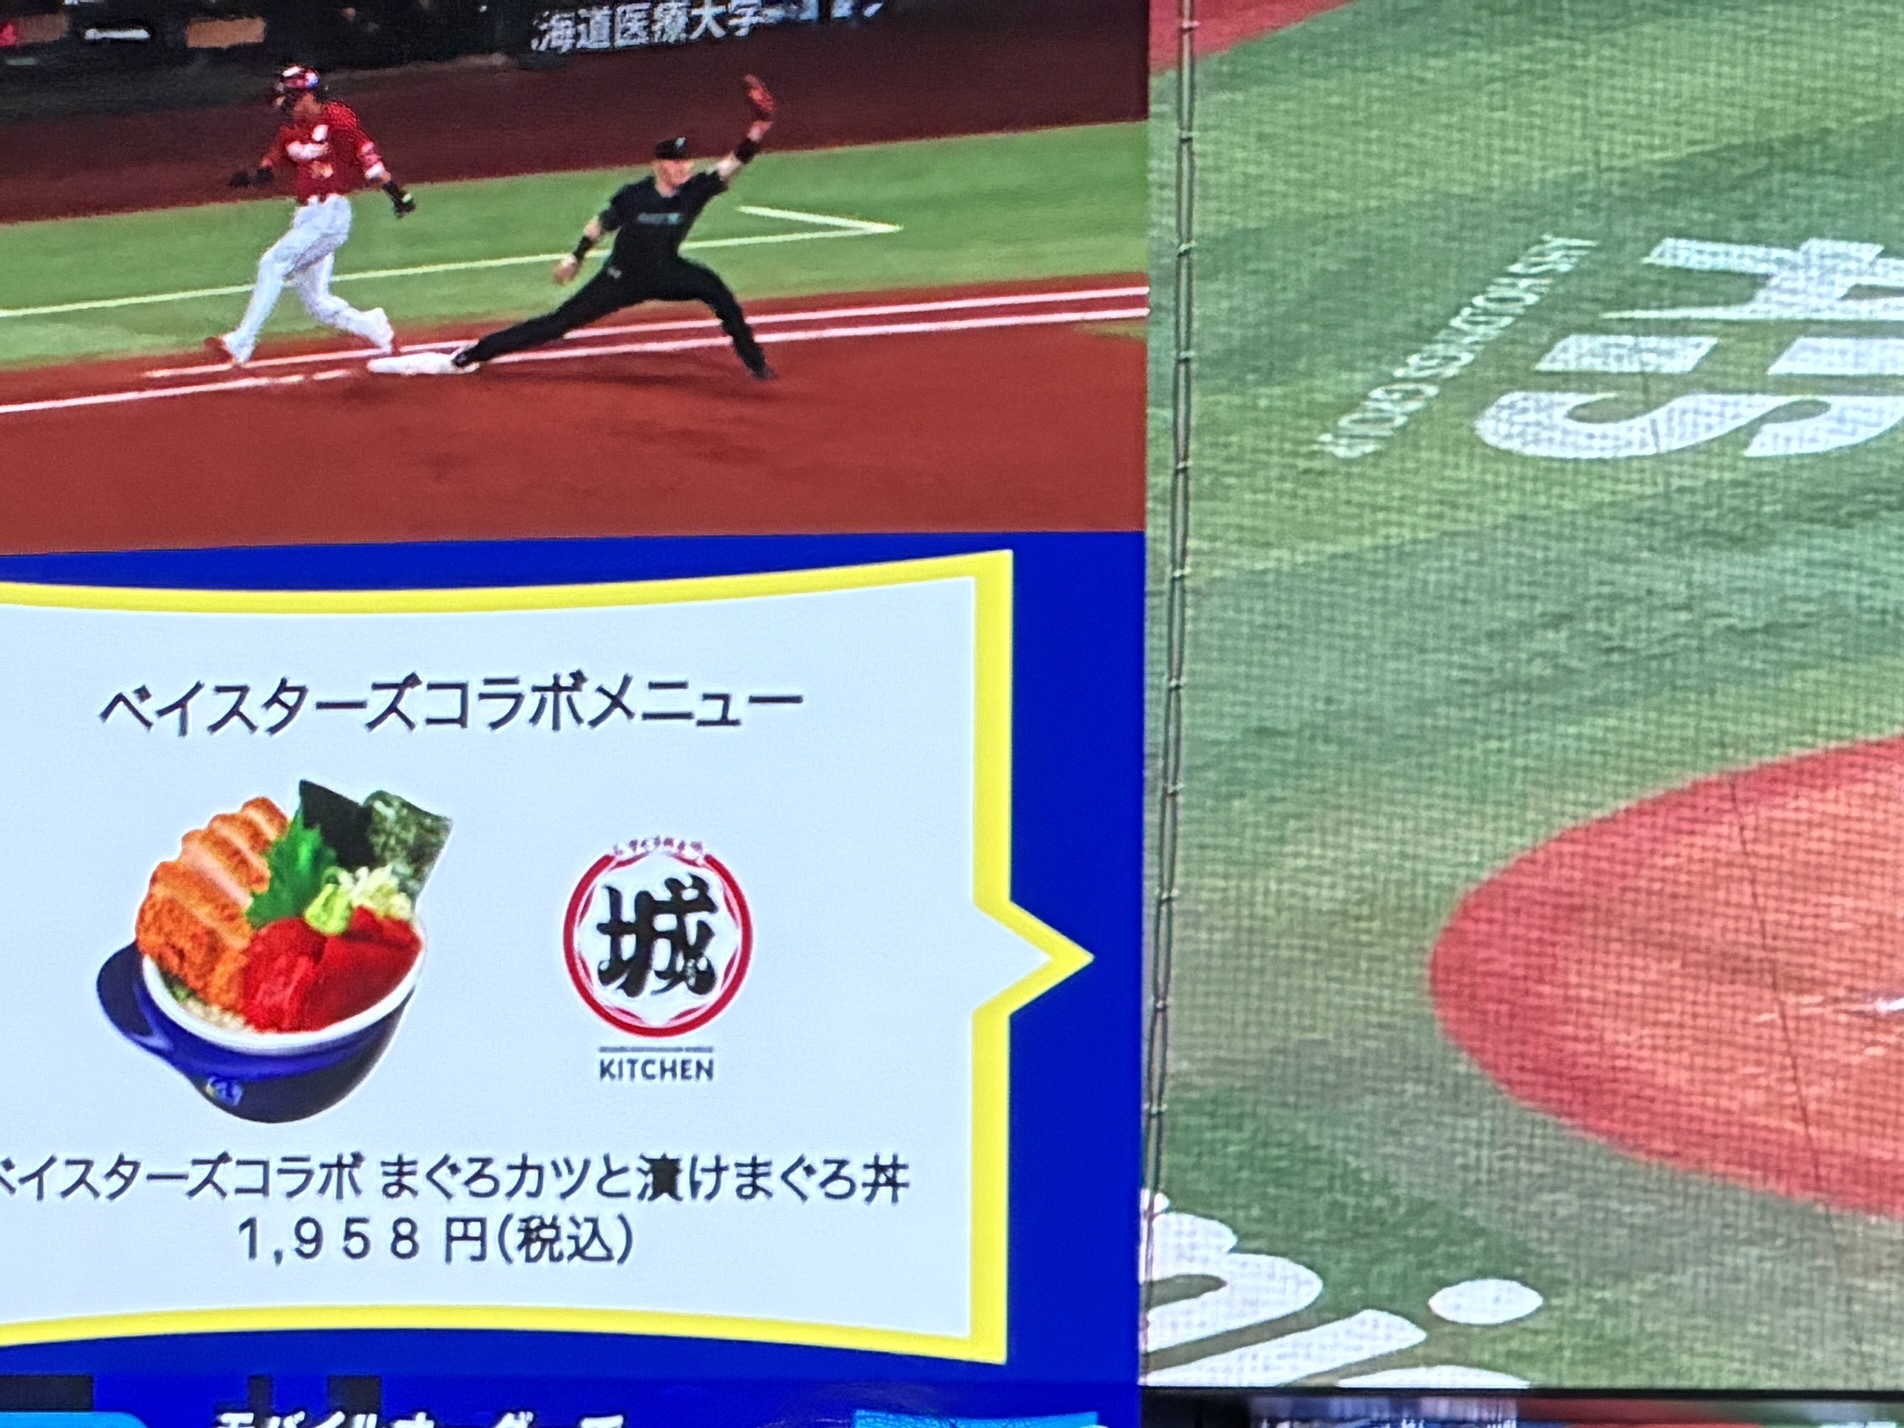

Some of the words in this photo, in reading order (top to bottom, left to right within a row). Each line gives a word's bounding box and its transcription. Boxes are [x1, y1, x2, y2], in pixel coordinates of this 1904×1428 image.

[101, 671, 804, 738] ベイスターズコラボメニュー
[596, 871, 719, 998] 城
[599, 1058, 714, 1082] KITCHEN
